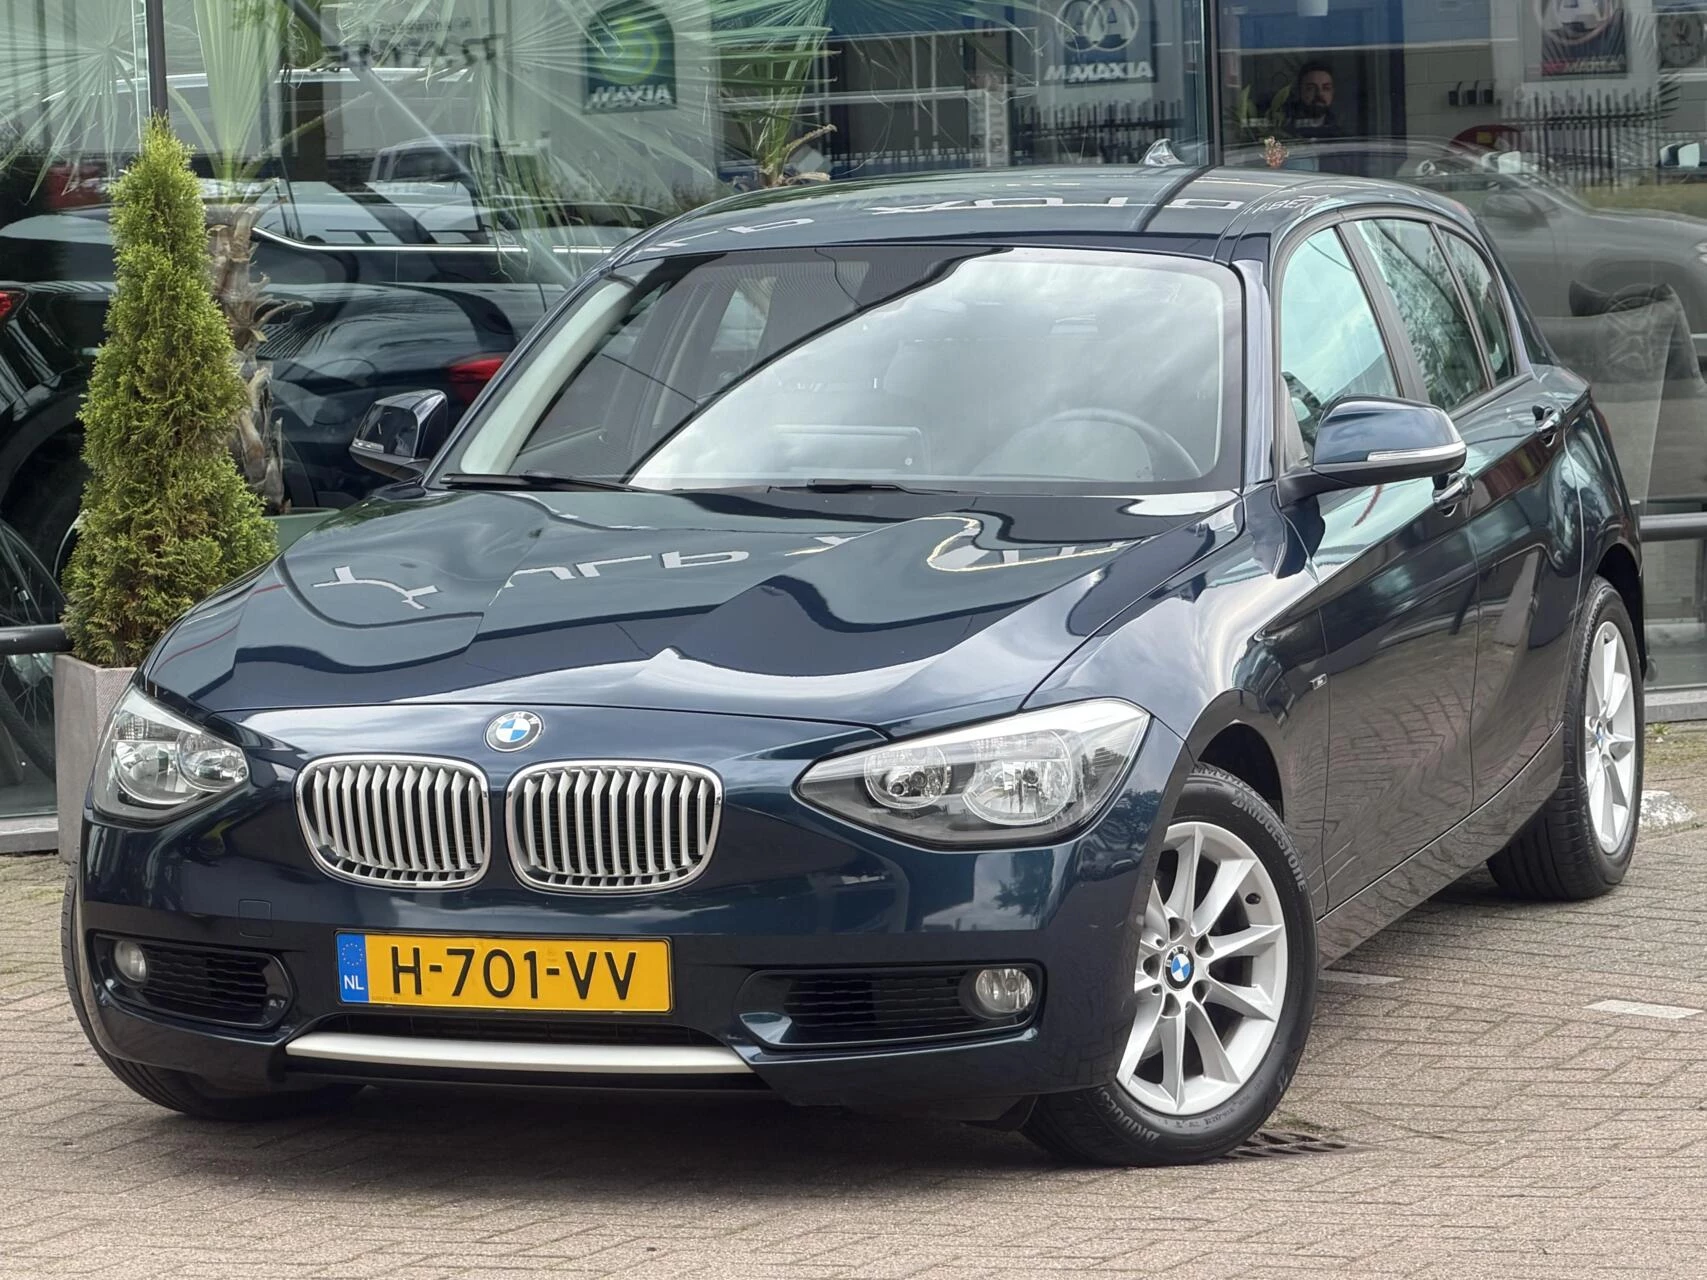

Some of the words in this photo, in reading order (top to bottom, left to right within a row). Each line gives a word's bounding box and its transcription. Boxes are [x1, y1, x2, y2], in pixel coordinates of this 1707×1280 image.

[1231, 788, 1306, 892] BRIDGESTONE
[343, 974, 365, 991] NL
[390, 946, 637, 1001] H-701-VV
